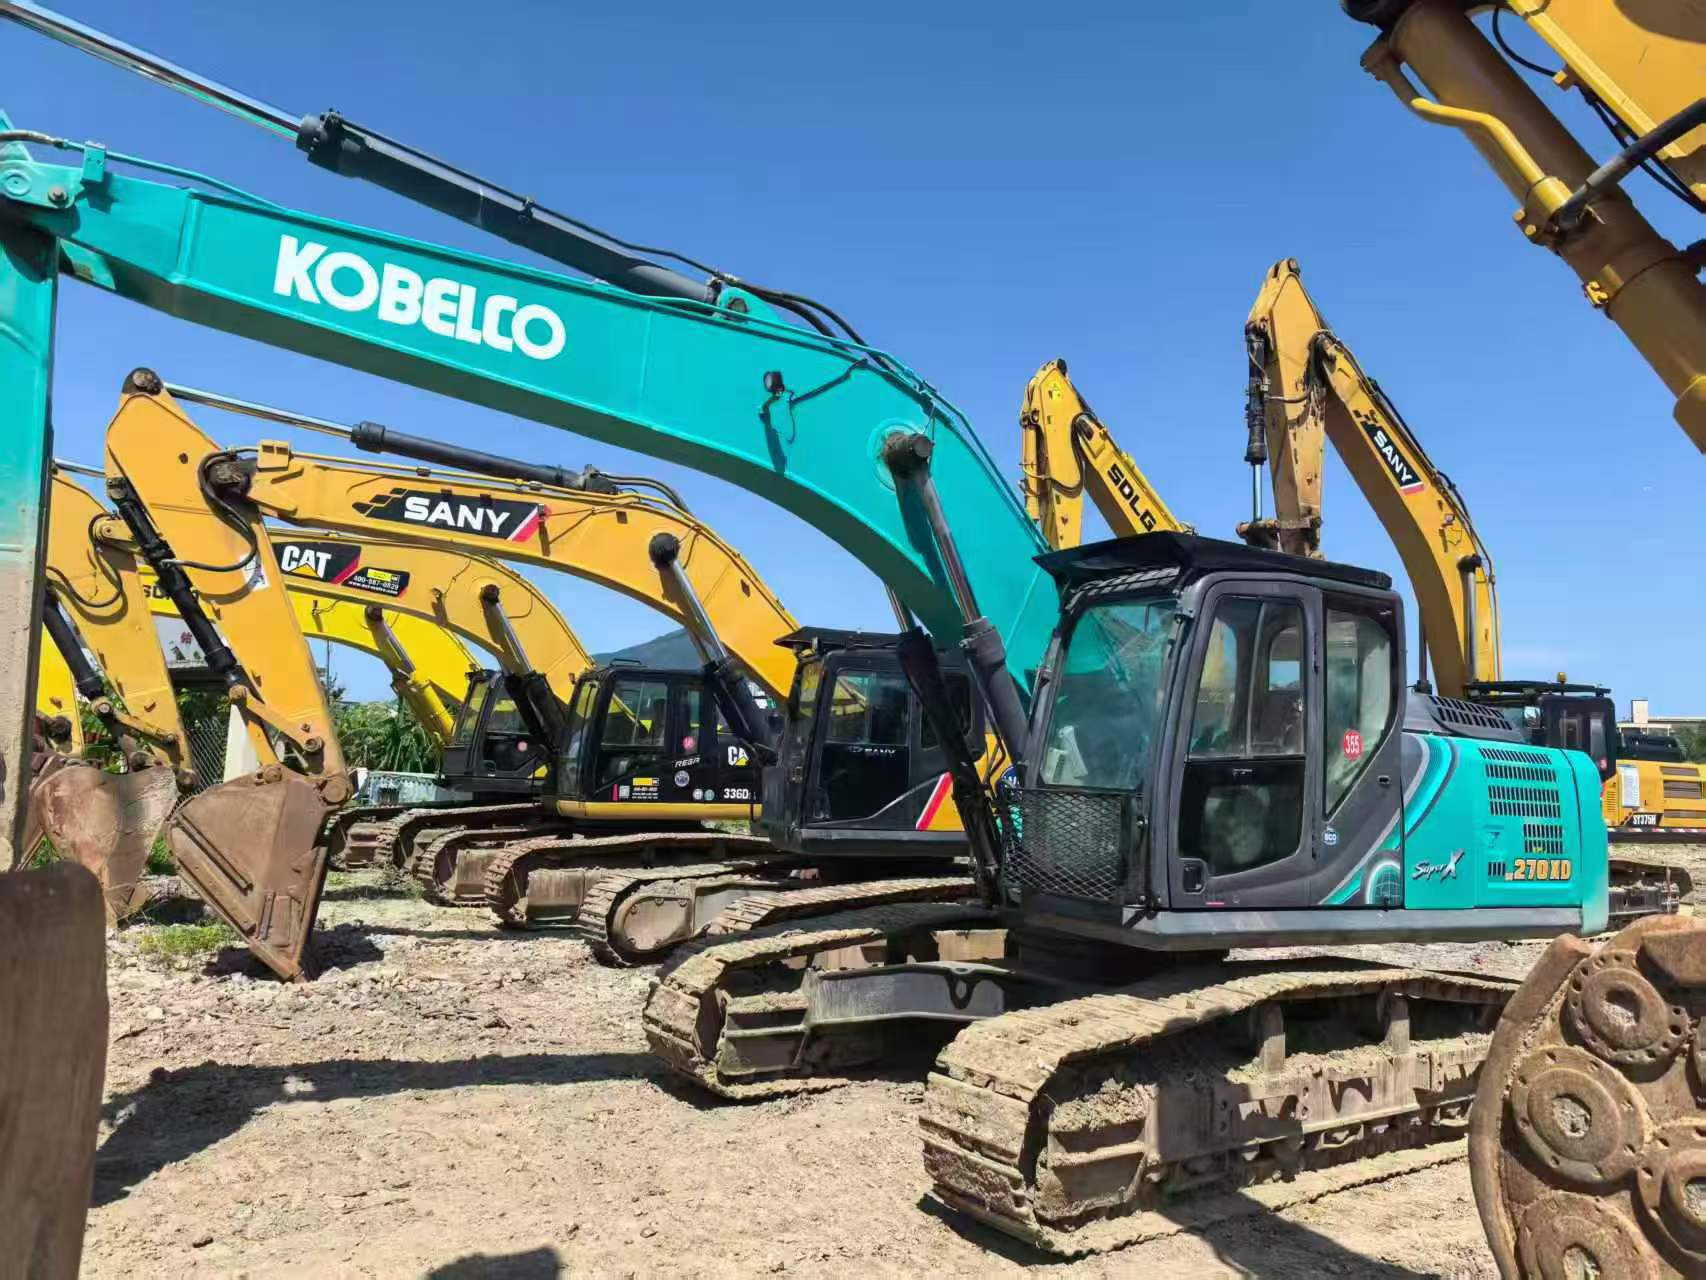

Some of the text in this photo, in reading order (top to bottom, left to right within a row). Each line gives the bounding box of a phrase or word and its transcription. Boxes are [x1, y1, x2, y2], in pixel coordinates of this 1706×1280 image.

[273, 234, 567, 360] KOBELCO
[1374, 430, 1413, 482] SANY
[403, 496, 512, 534] SANY
[1107, 463, 1157, 532] SDLG
[281, 544, 332, 579] CAT
[1632, 814, 1657, 825] SY375H
